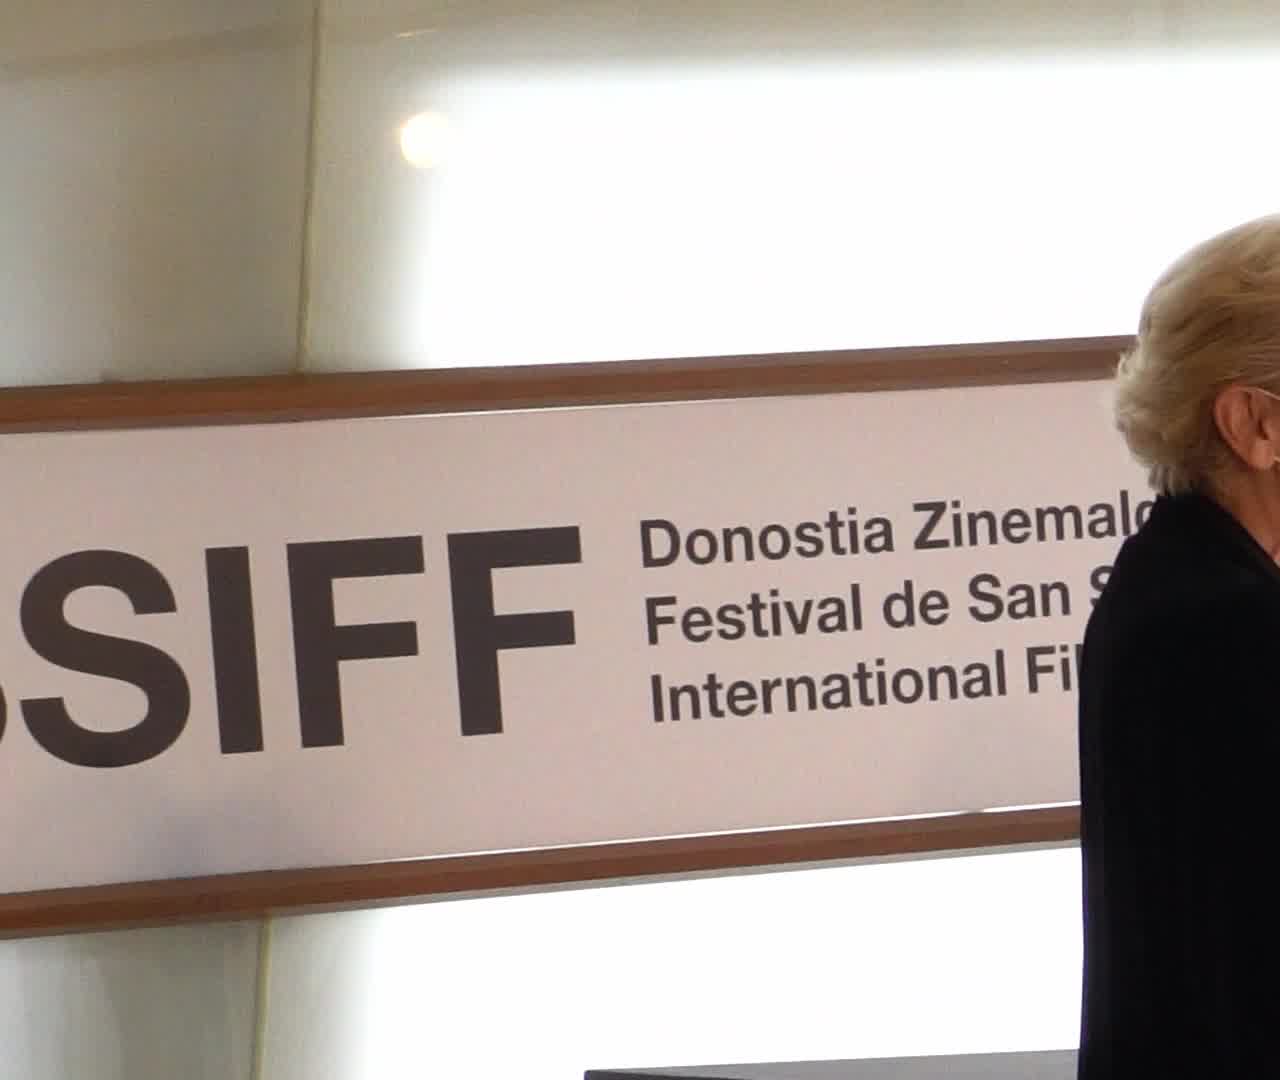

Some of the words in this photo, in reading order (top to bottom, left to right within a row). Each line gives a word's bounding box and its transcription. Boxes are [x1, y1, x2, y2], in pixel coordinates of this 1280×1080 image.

[640, 506, 895, 568] Donostia
[913, 490, 1156, 550] Zinemal
[0, 526, 582, 768] SIFF
[645, 583, 862, 646] Festival
[882, 579, 949, 629] de
[968, 573, 1071, 622] San
[651, 648, 1007, 722] International
